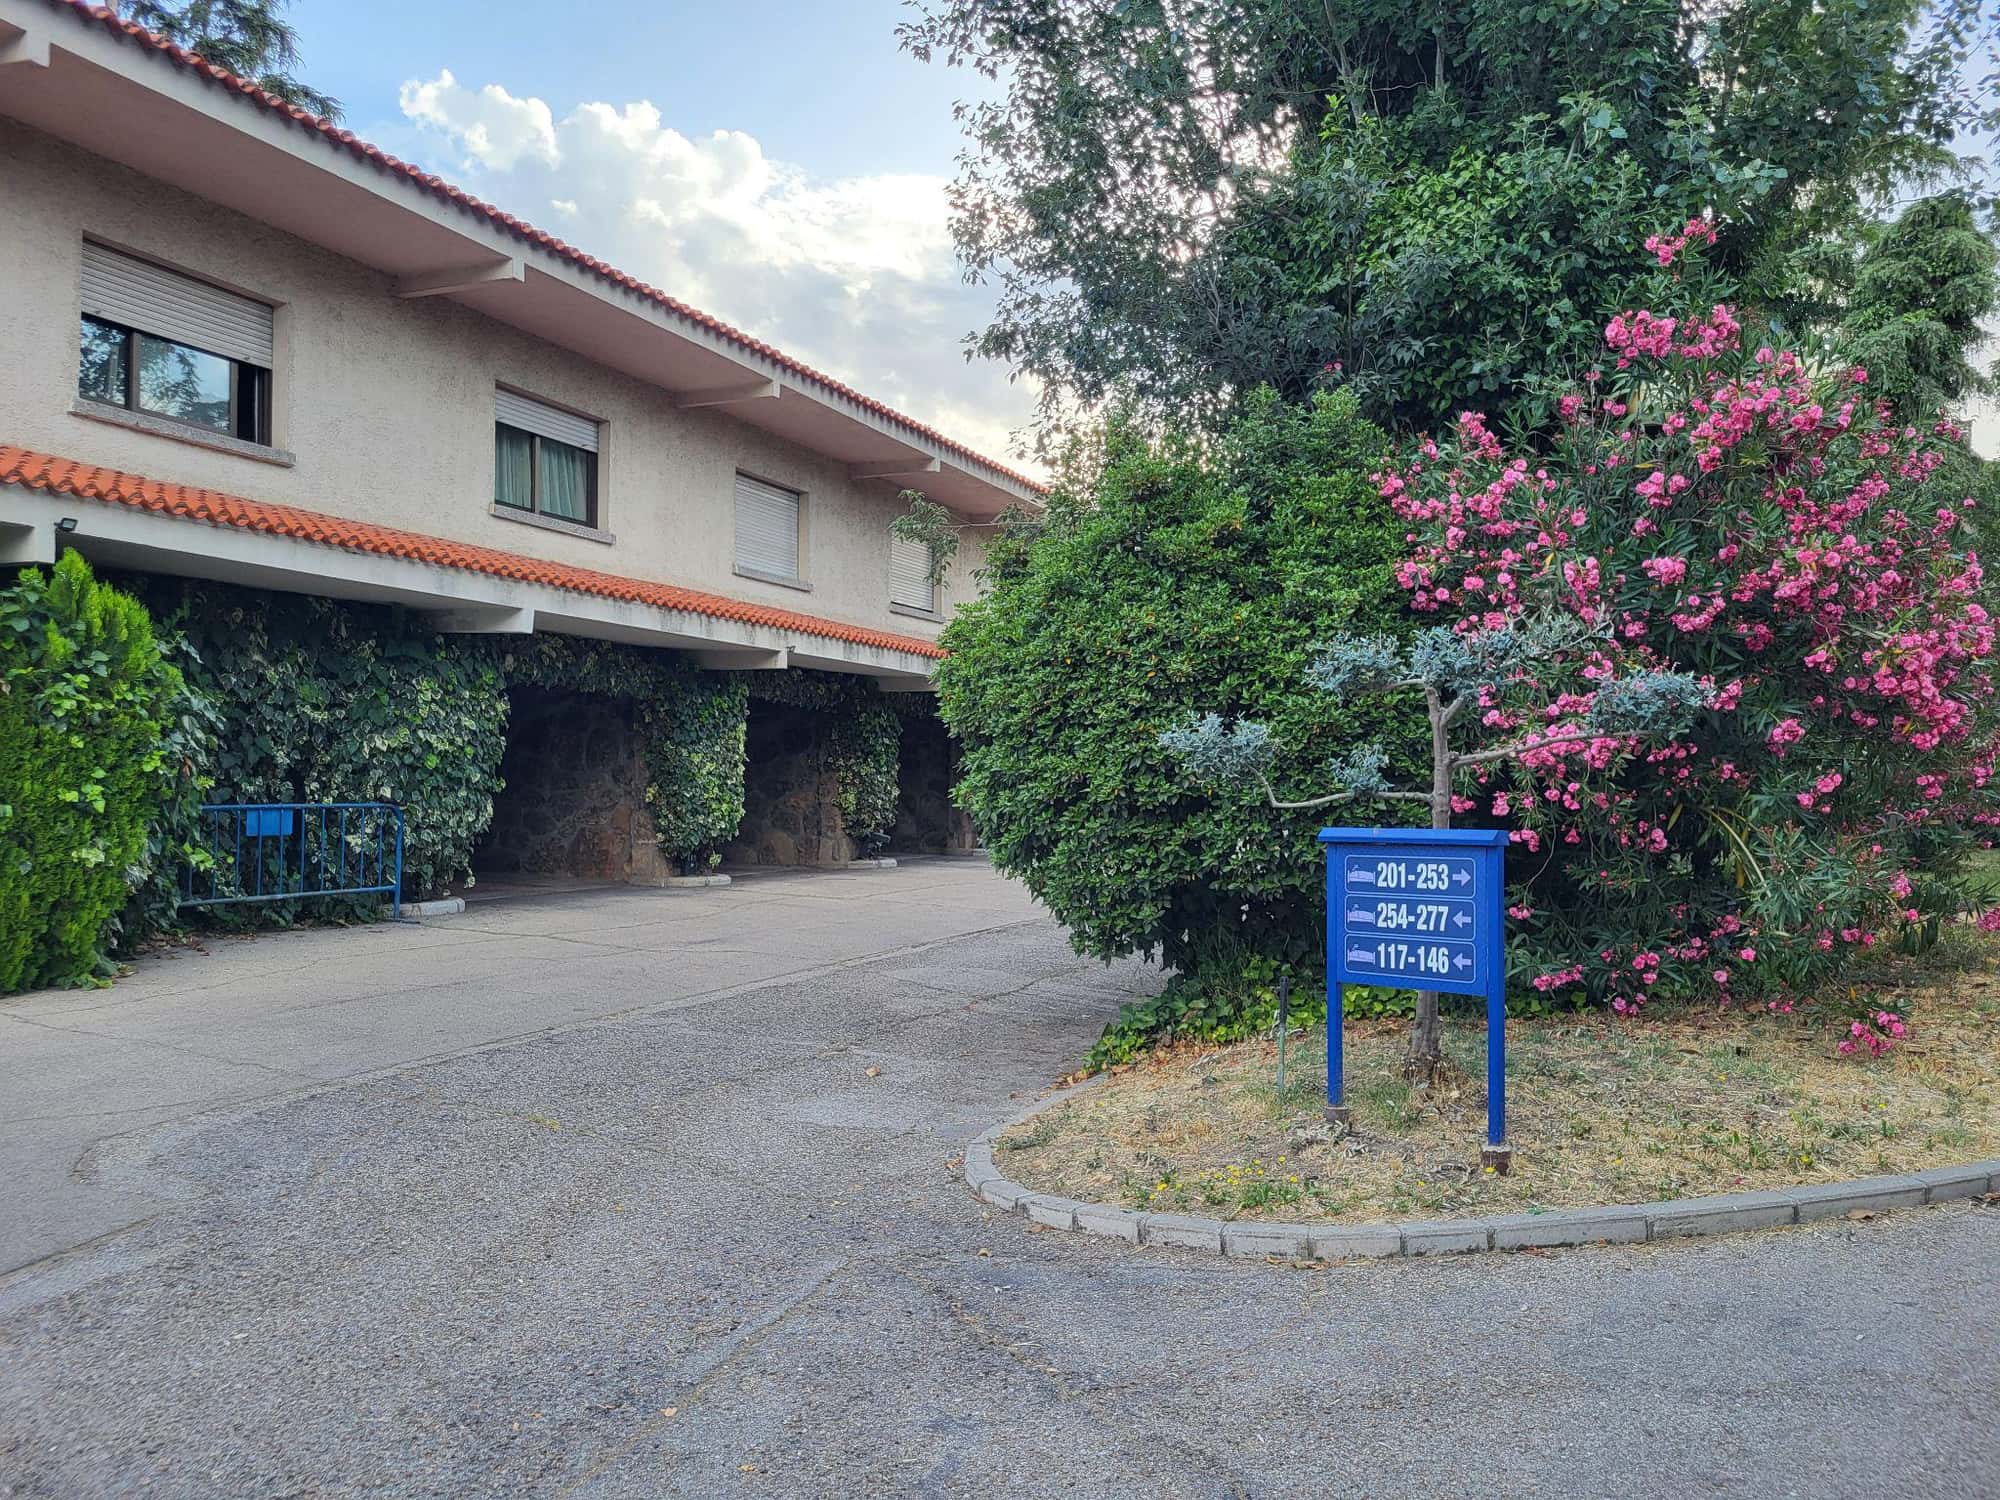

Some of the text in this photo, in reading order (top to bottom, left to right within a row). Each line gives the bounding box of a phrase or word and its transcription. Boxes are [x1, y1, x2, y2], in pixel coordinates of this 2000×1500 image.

[1377, 862, 1449, 890] 201-253
[1377, 902, 1449, 931] 254-277
[1377, 943, 1449, 974] 117-146
